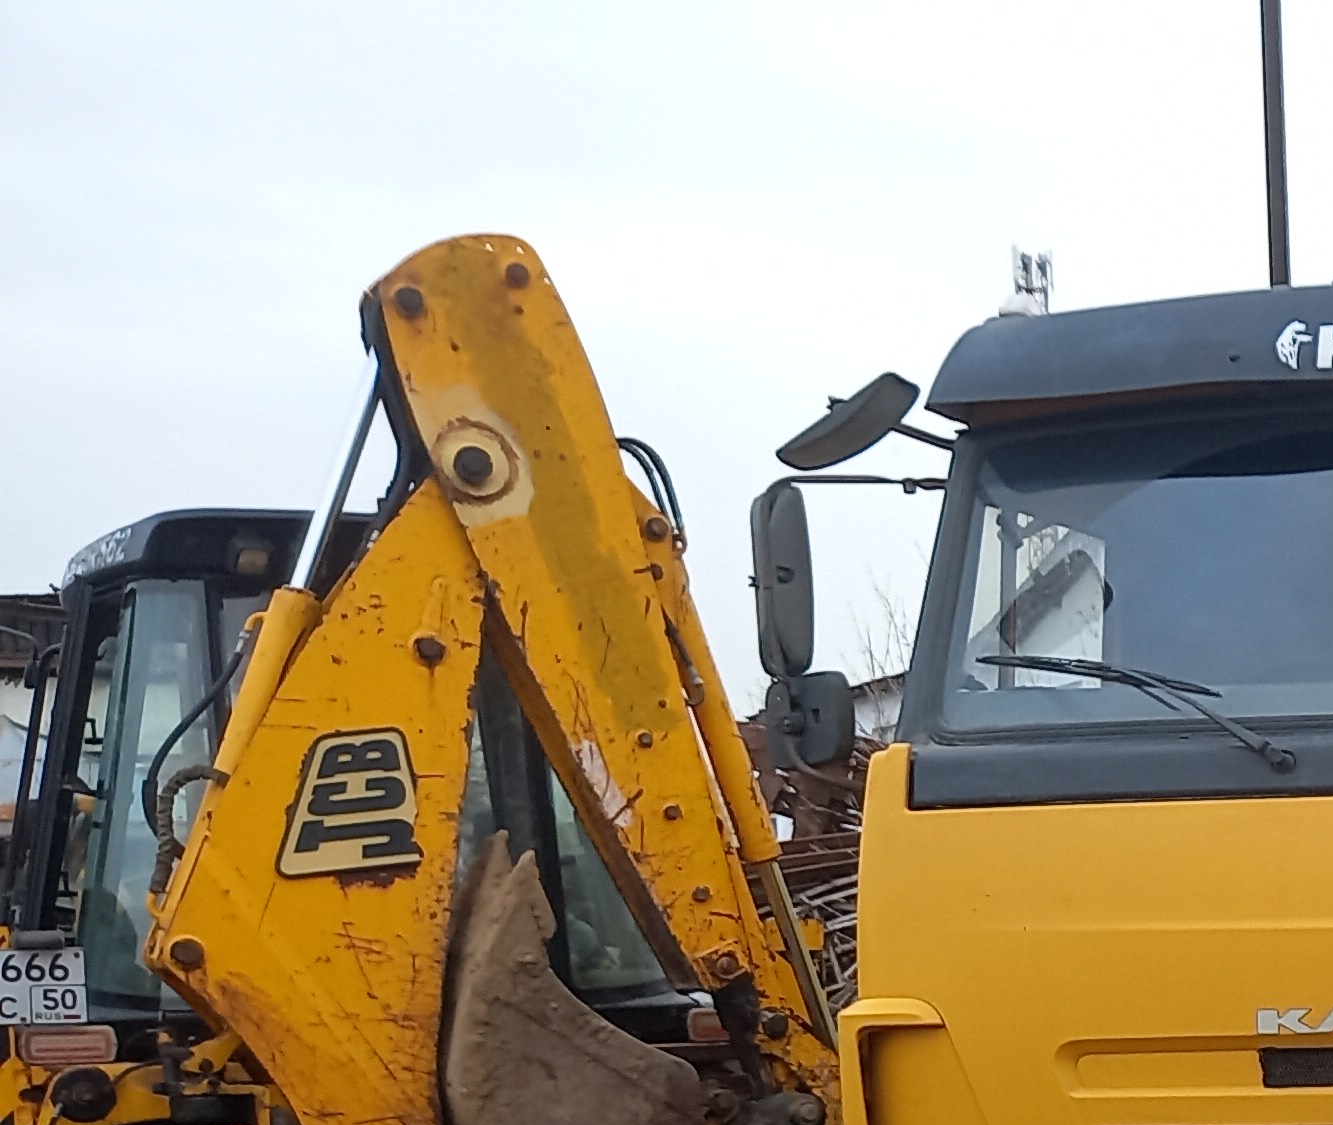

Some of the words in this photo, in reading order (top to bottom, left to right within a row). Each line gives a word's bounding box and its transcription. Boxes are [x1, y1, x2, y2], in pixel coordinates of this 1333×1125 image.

[293, 738, 420, 859] JCB
[42, 988, 78, 1010] 50
[35, 1012, 62, 1020] RUS
